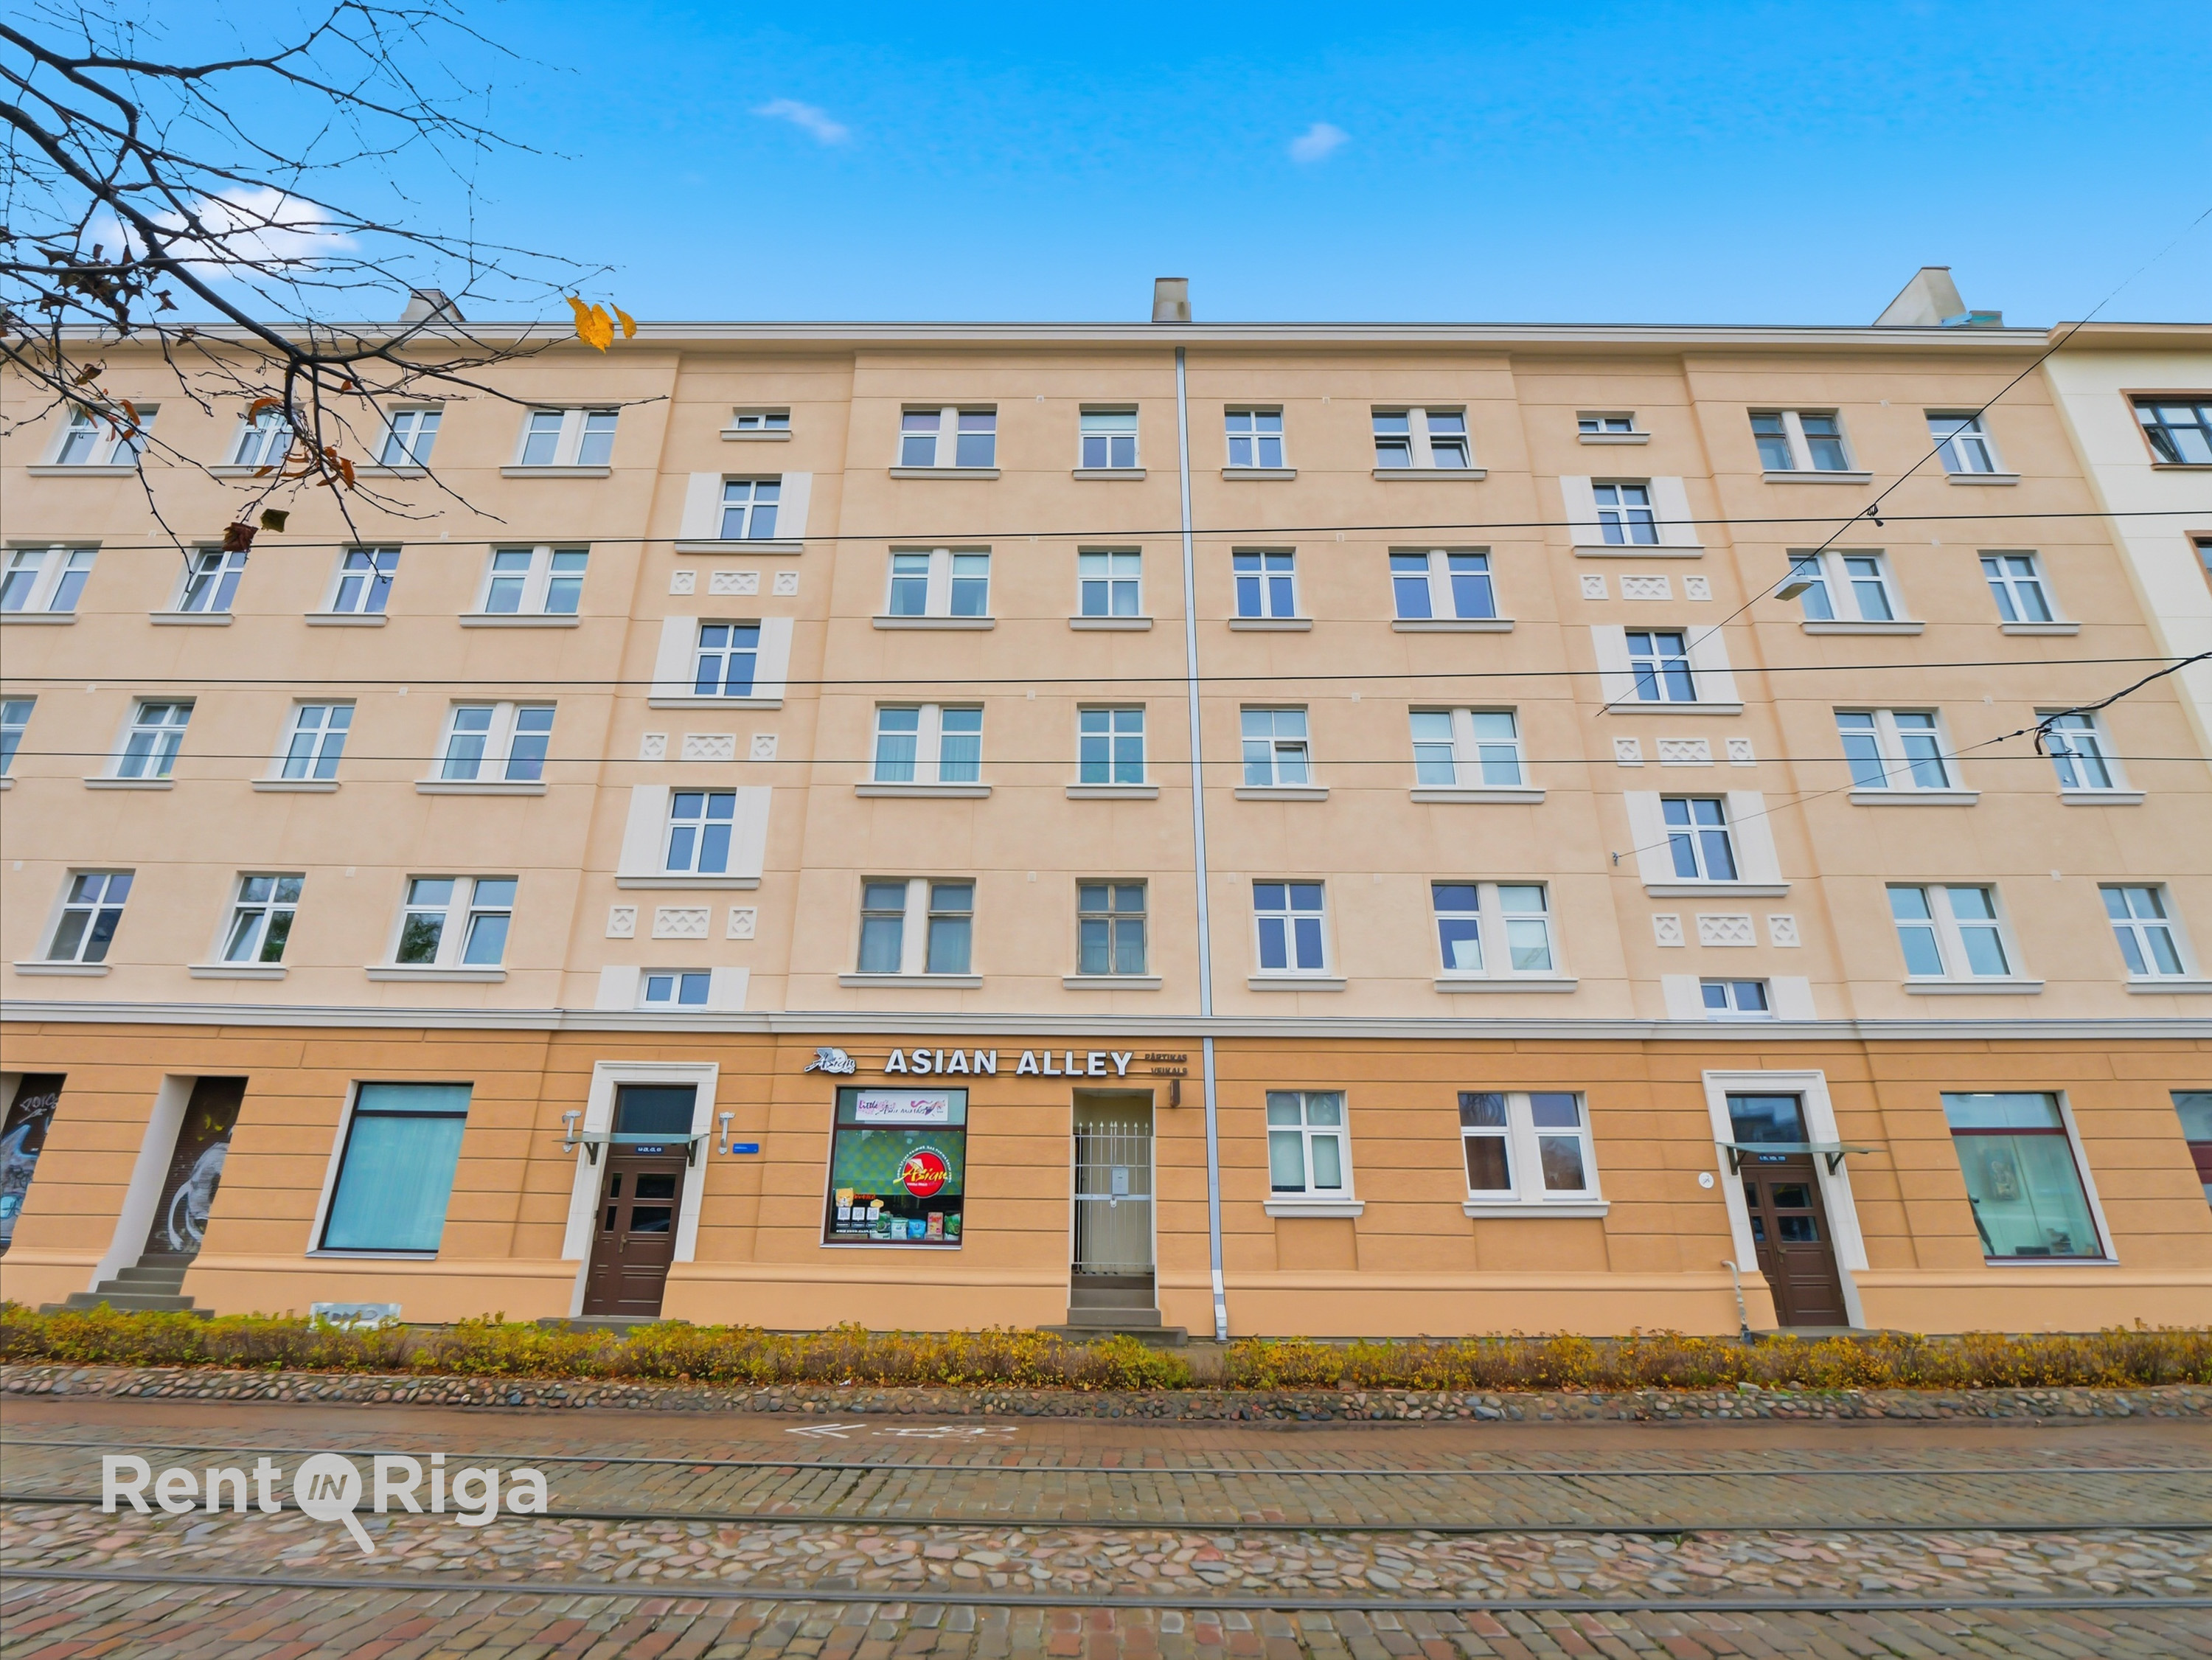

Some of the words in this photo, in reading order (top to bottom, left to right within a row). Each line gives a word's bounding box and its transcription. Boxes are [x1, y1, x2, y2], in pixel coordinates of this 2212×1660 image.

[885, 1048, 997, 1074] ASIAN
[1015, 1050, 1133, 1077] ALLEY
[893, 1167, 948, 1185] Asian
